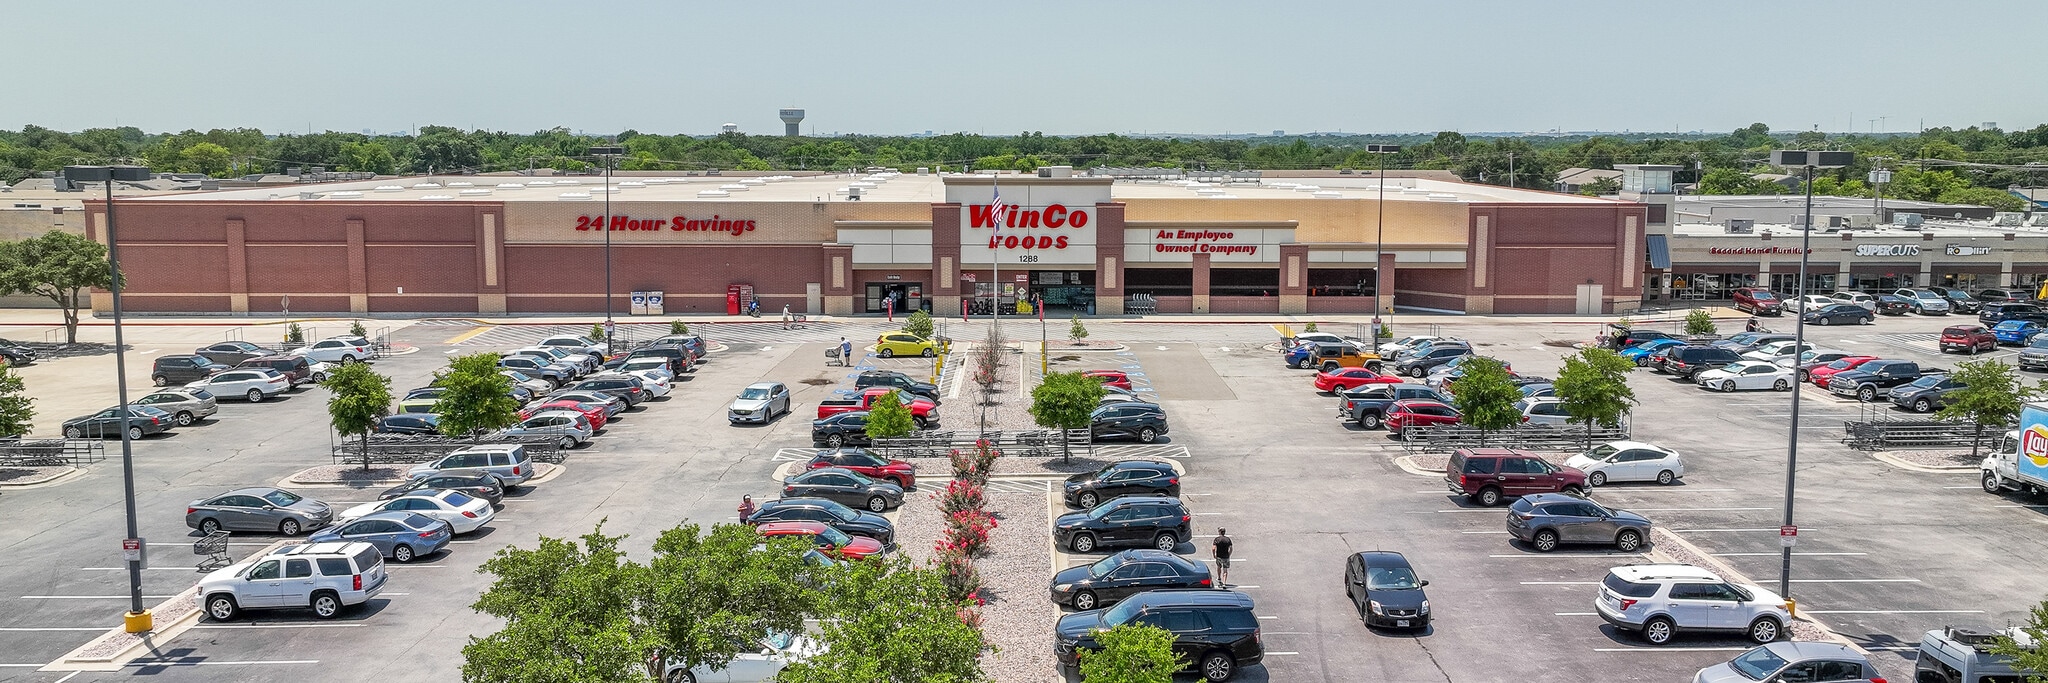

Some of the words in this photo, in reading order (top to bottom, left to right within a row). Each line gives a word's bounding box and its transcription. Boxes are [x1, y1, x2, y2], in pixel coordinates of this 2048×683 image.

[969, 203, 1088, 229] WinCo
[575, 215, 605, 231] 24
[609, 215, 667, 232] Hour
[670, 214, 756, 236] Savings
[1156, 230, 1174, 239] An
[1177, 230, 1234, 242] Employee
[988, 235, 1069, 250] FOODS
[1155, 243, 1198, 253] Owned
[1200, 243, 1258, 256] Company
[1710, 246, 1743, 255] Second
[1745, 246, 1770, 255] Home
[1772, 246, 1812, 255] Furnitue
[1855, 244, 1920, 256] SUPERCUTS
[1019, 255, 1039, 263] 1288
